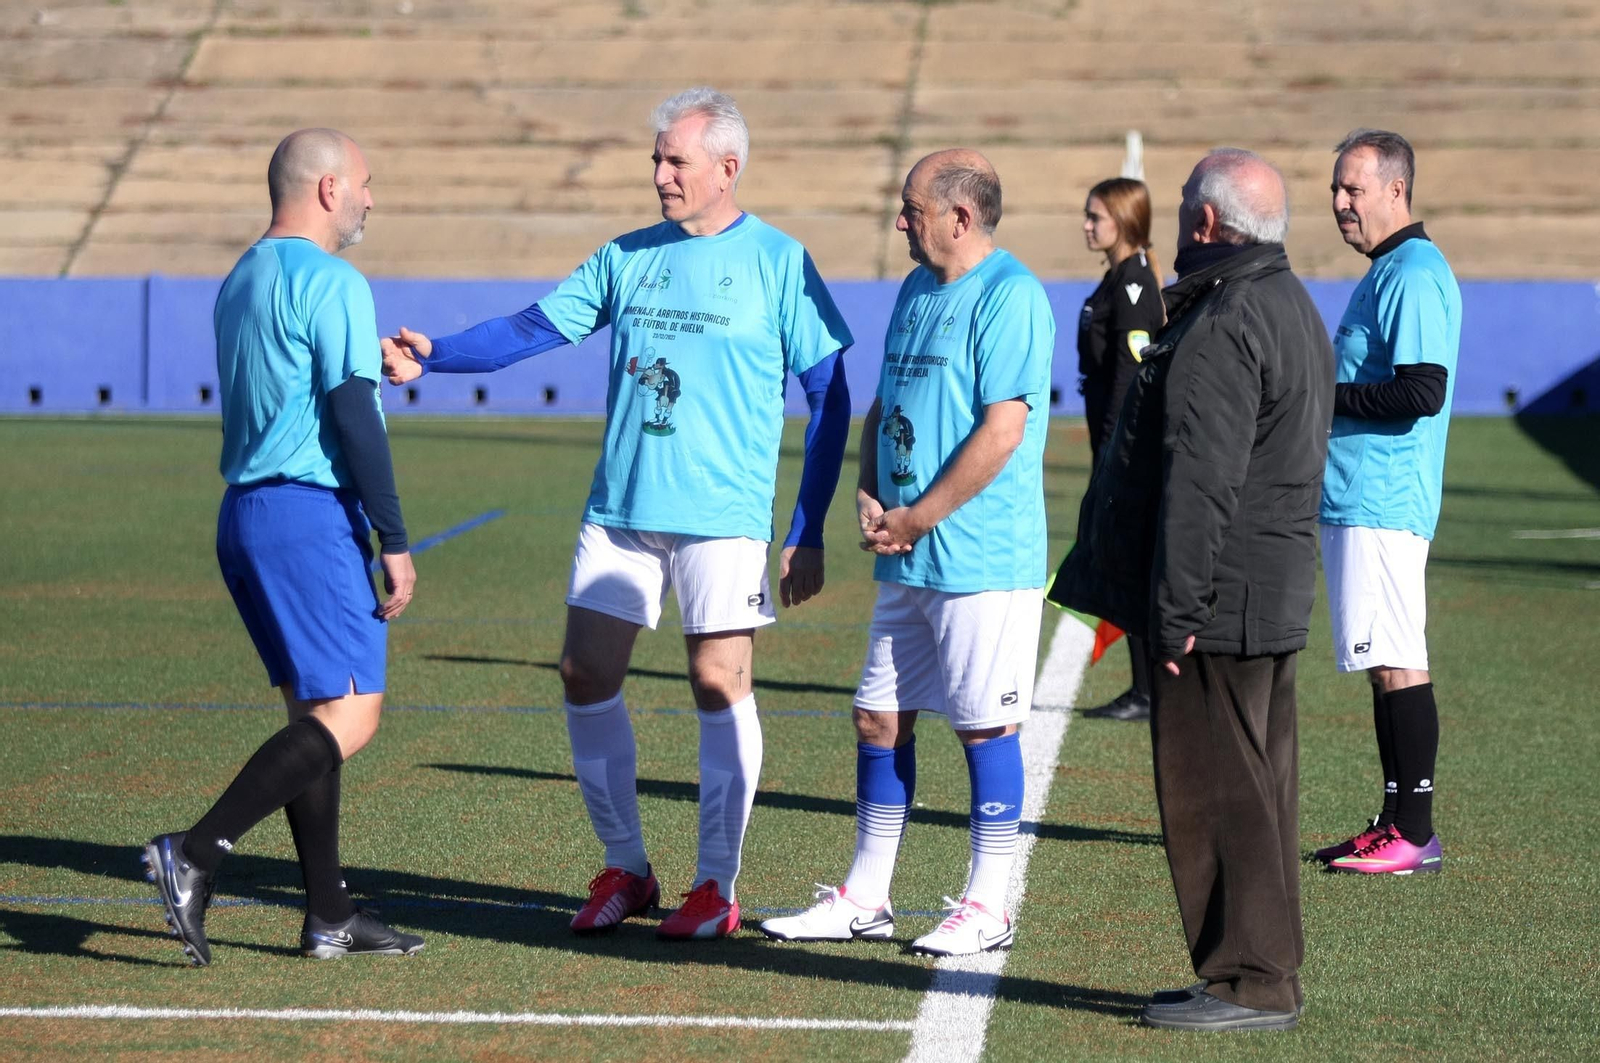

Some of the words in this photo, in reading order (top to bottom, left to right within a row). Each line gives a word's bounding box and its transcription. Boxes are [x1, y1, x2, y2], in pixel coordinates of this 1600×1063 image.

[632, 317, 642, 328] DE
[642, 318, 668, 331] FÚTBOL
[669, 322, 680, 332] DE
[680, 323, 705, 334] HUELVA
[656, 307, 689, 320] ÁRBITROS
[690, 312, 731, 327] HISTÓRICOS
